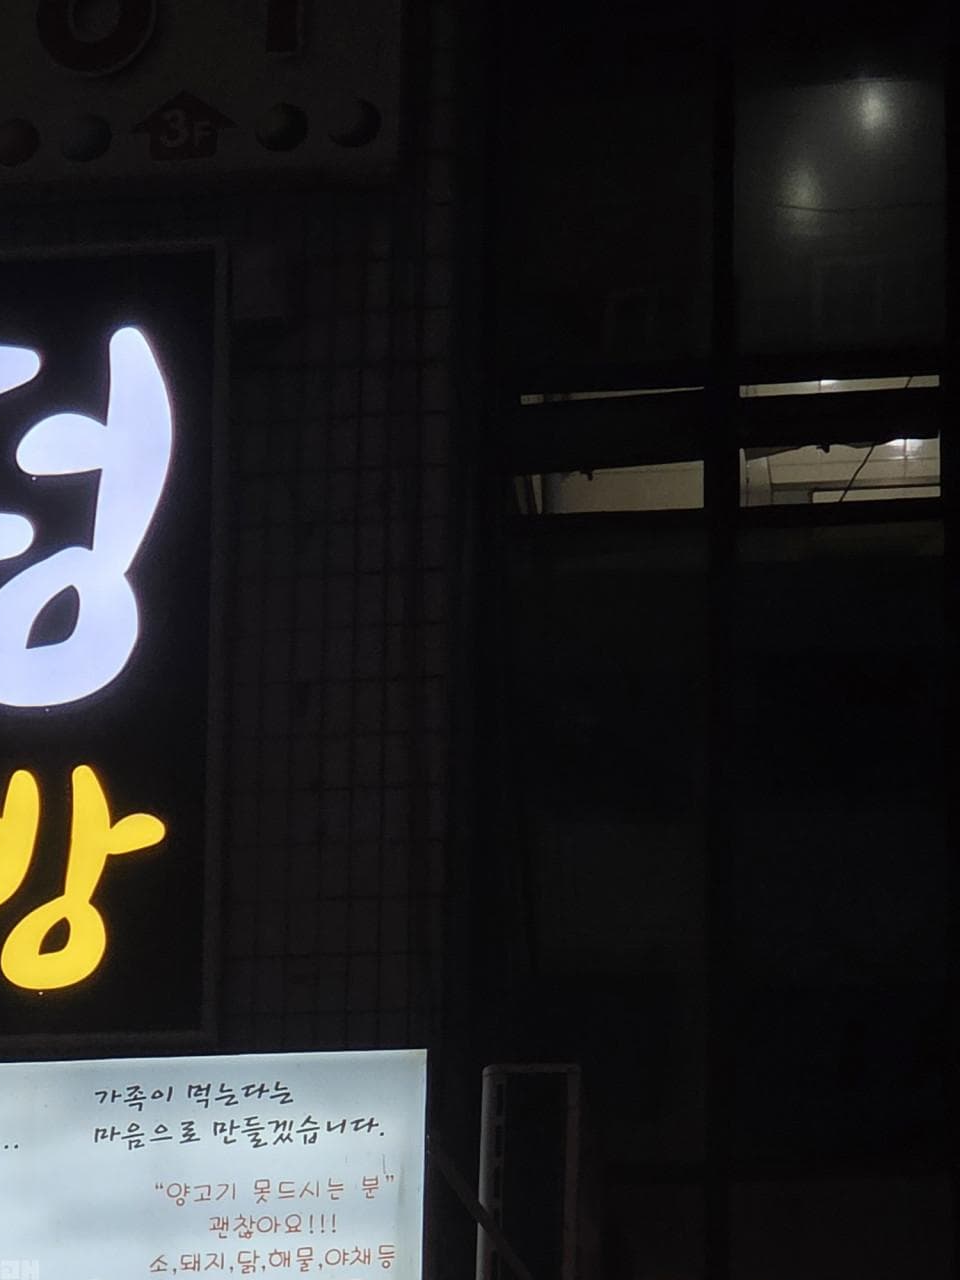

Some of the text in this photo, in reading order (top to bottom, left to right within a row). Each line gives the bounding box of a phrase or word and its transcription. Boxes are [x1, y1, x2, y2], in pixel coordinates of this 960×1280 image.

[95, 1081, 294, 1112] 가족이 먹는다는
[94, 1115, 385, 1151] 마음으로 만들겠습니다.
[253, 1177, 344, 1204] 못드시는
